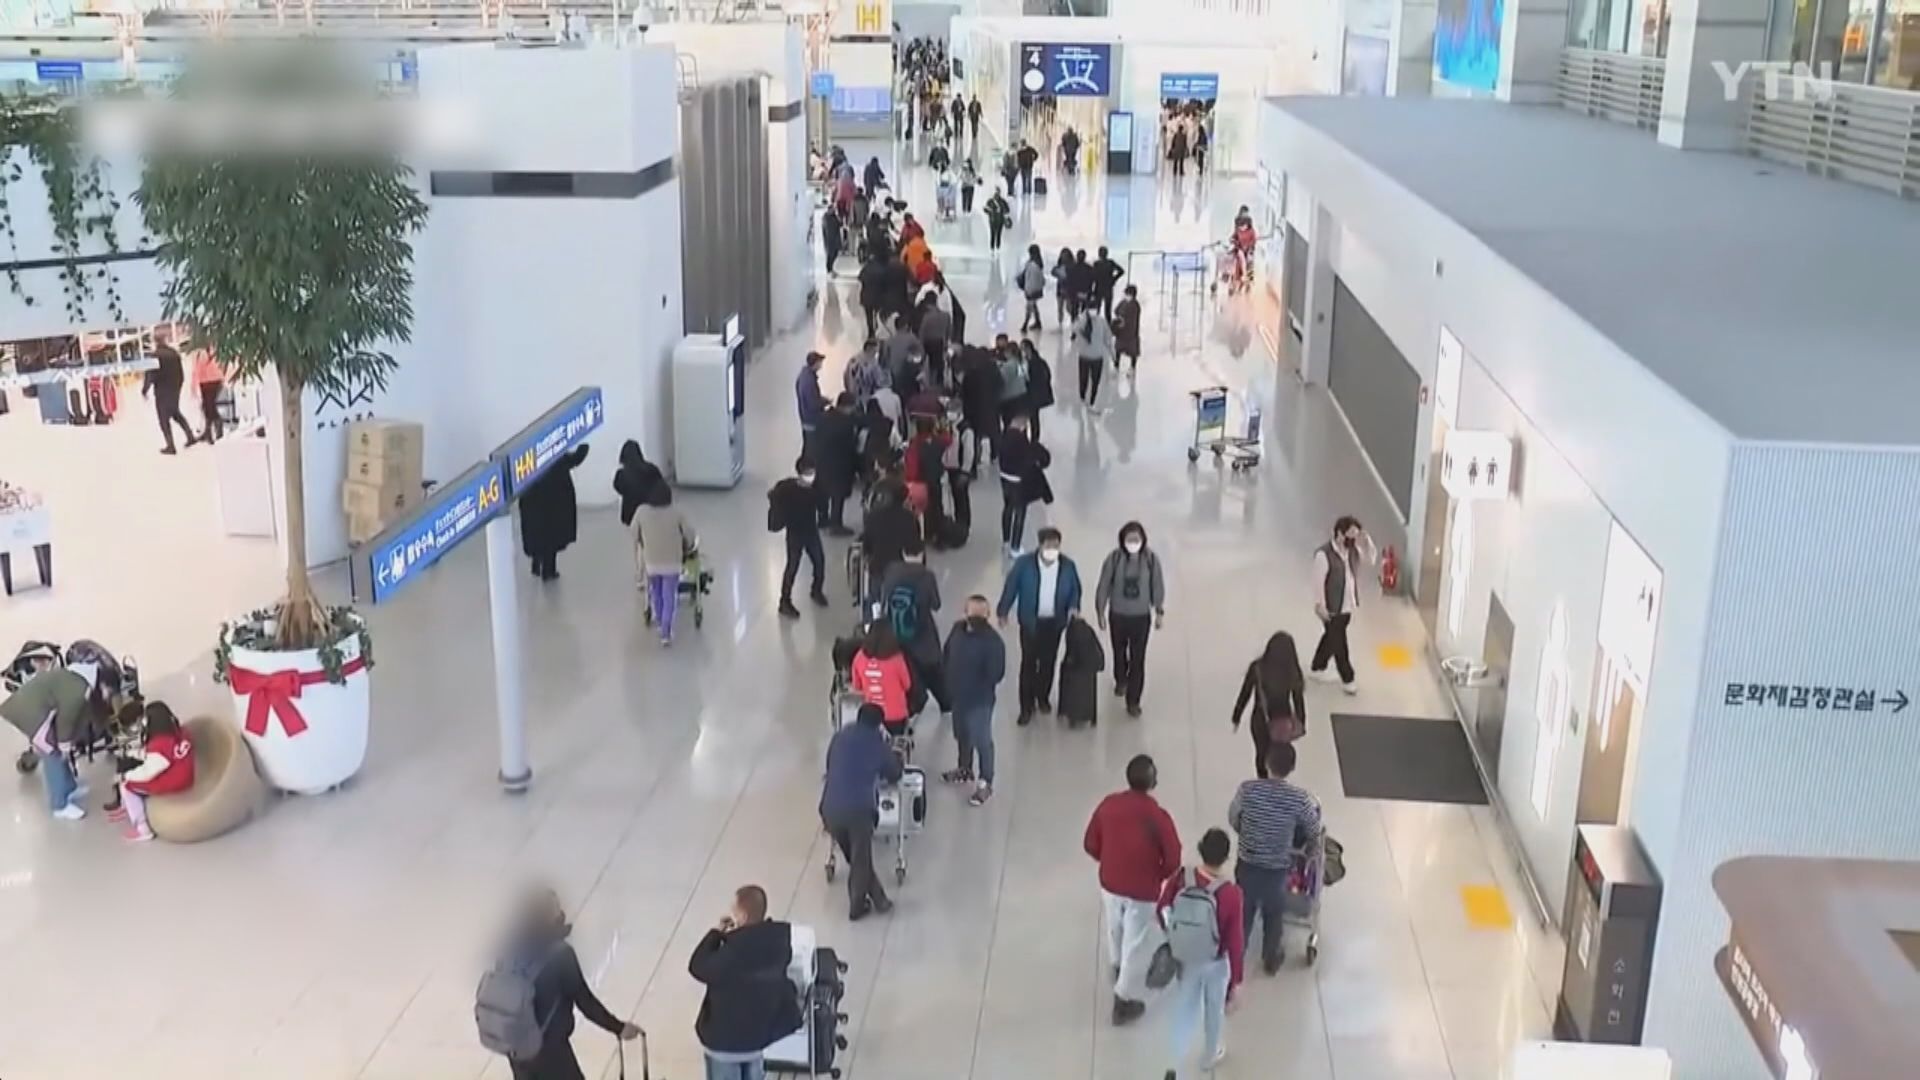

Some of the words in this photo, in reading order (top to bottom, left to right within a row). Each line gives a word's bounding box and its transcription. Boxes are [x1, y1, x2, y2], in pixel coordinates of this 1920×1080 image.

[856, 3, 881, 32] H
[1028, 51, 1040, 68] 4
[317, 411, 374, 431] PLAZA
[478, 475, 499, 513] A-G
[1724, 683, 1876, 712] 문화재감정관실
